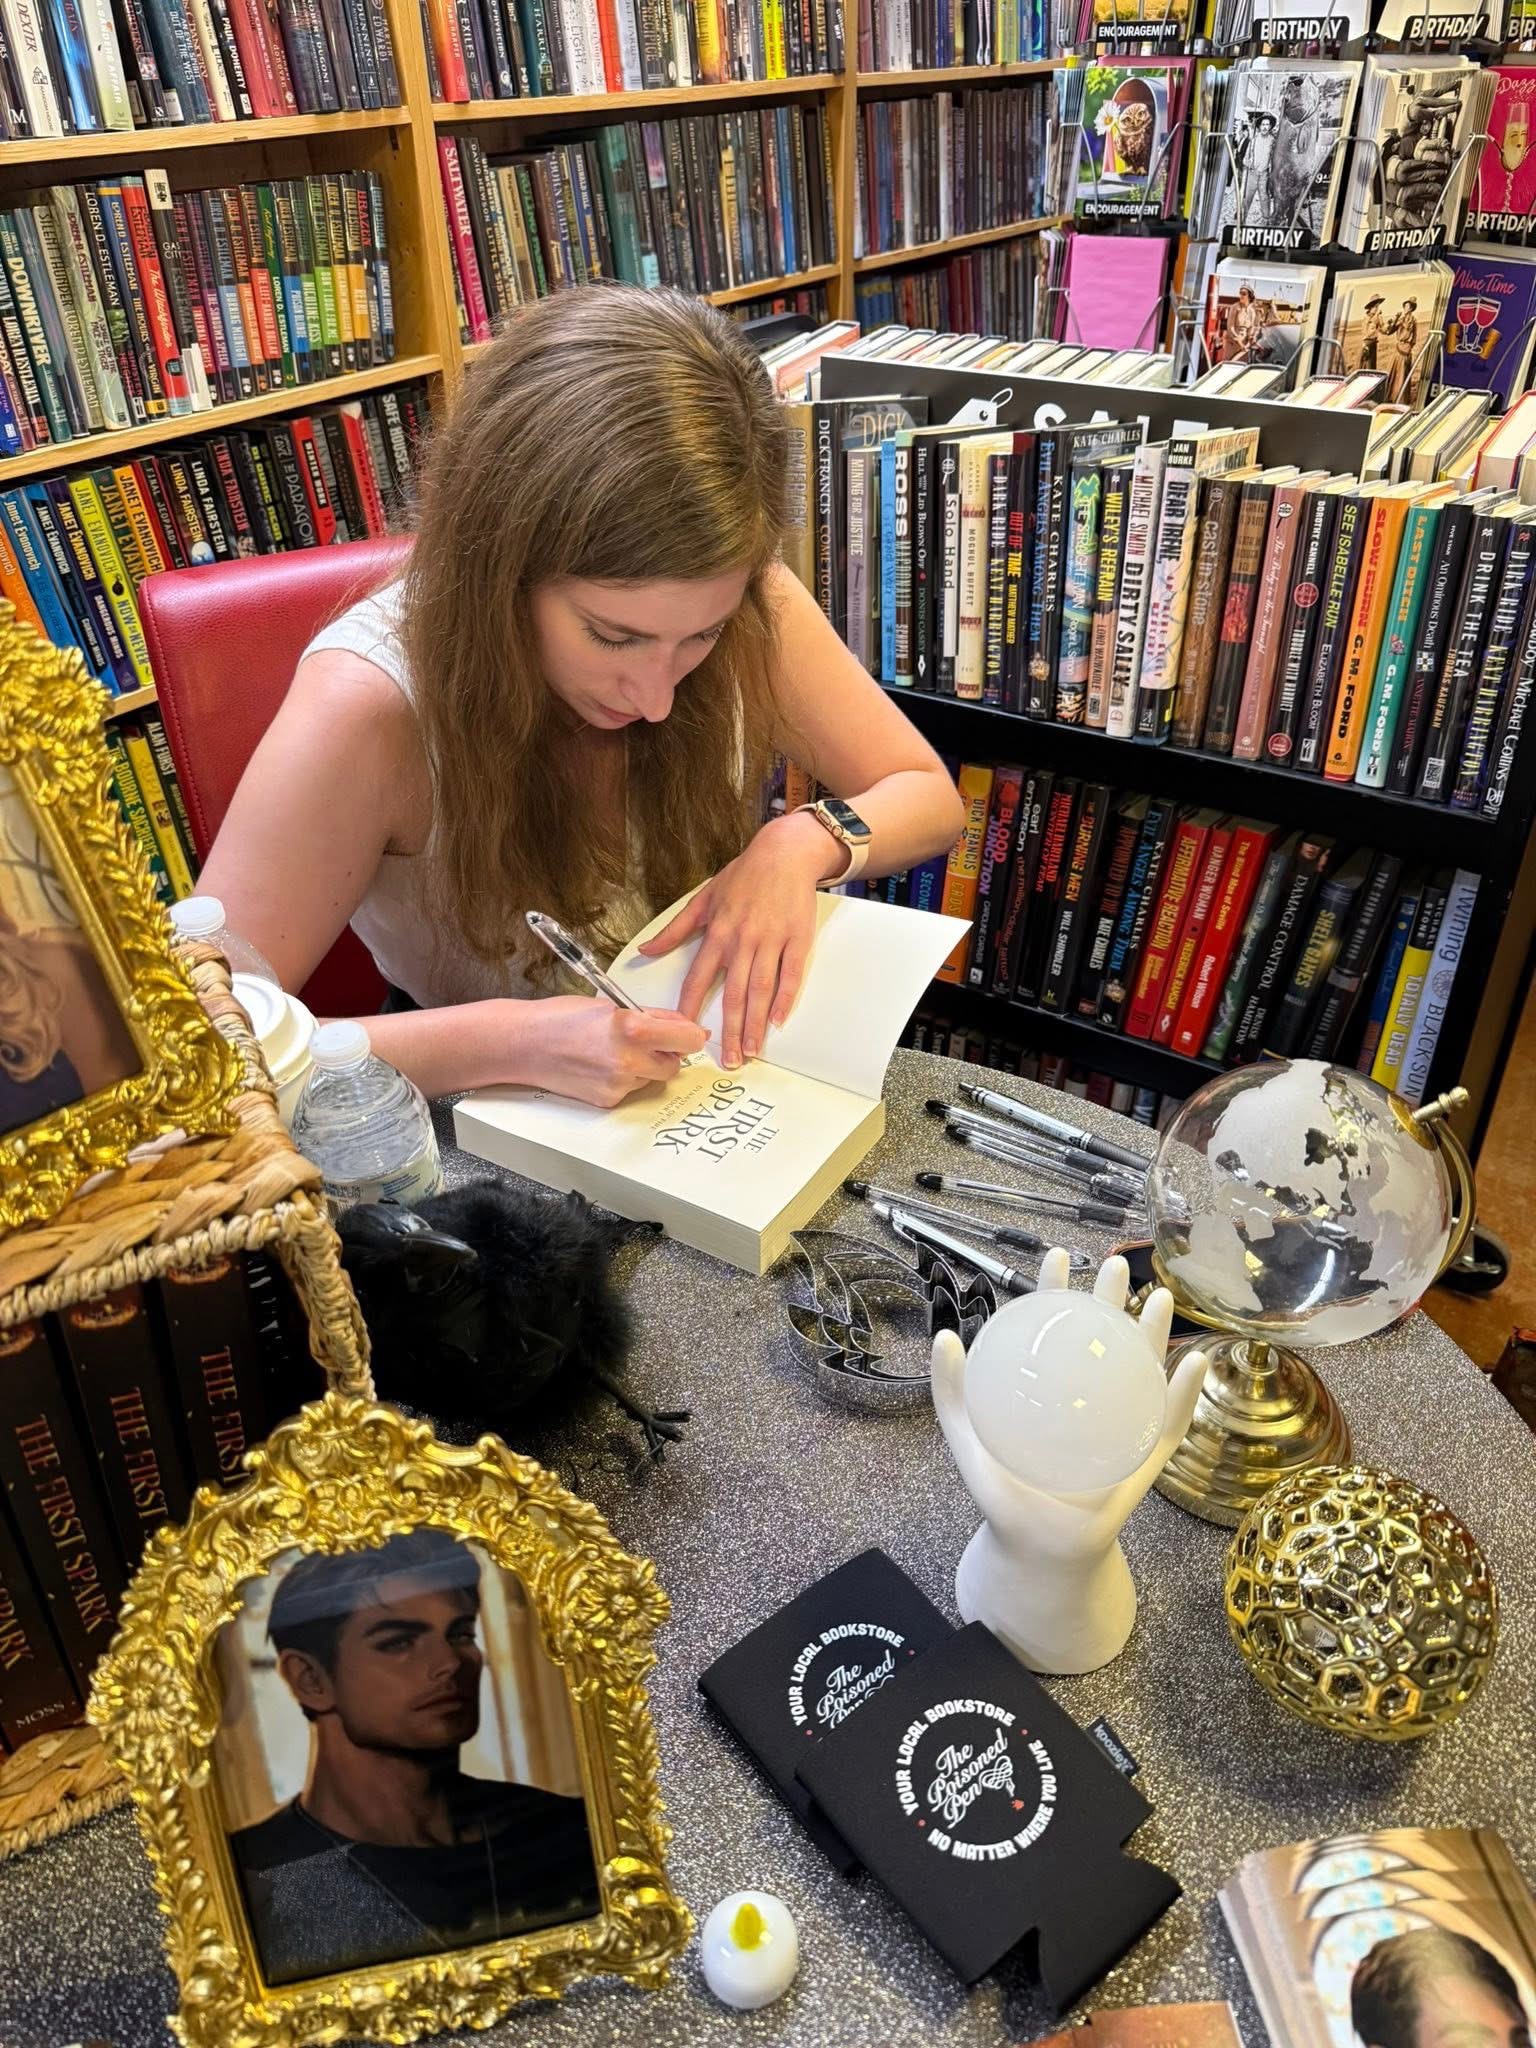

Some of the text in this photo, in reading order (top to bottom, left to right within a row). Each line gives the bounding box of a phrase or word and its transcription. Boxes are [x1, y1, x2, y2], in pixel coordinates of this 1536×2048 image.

[16, 2, 37, 52] DEXTER
[222, 17, 246, 89] PAUL DOHERTY
[357, 4, 373, 67] DUNNING
[461, 17, 474, 58] EXILES
[1099, 24, 1177, 37] ENCOURAGEMENT
[1261, 19, 1342, 40] BIRTHDAY
[1410, 17, 1484, 39] BIRTHDAY
[444, 146, 472, 238] SALTWATER
[1085, 203, 1160, 216] ENCOURAGEMENT
[1465, 211, 1536, 233] BIRTHDAY
[39, 213, 74, 306] SILENT THUNDER
[85, 192, 104, 230] LOREN
[99, 249, 121, 306] ESTLEMAN
[1232, 227, 1305, 248] BIRTHDAY
[1371, 228, 1440, 250] BIRTHDAY
[9, 256, 52, 367] DOWNRIVER
[1453, 265, 1517, 295] Wine Time
[382, 394, 412, 473] SAFE HOUSES
[817, 419, 832, 515] DICK FRANCIS
[1039, 440, 1056, 474] EVIL
[1168, 443, 1193, 465] JAN BURKE
[170, 463, 204, 543] LINDA FAIRSTEIN
[191, 461, 227, 553] LINDA FAIRSTEIN
[305, 441, 327, 505] WINTER WORK
[850, 458, 865, 556] MINING FOR JUSTICE
[1035, 480, 1052, 534] ANGELS
[75, 487, 119, 573] JANET EVANOVICH
[896, 450, 912, 607] ROSS MACDONALD
[943, 499, 957, 590] Solo Hand
[1009, 511, 1024, 532] OUT
[1045, 475, 1063, 612] KATE CHARLES
[1097, 492, 1123, 601] WILEY'S REFRAIN
[1156, 481, 1190, 565] DEAR IRENE,
[1305, 501, 1326, 576] DOROTHY CANNELL
[57, 502, 124, 659] JANET EVANOVICH DANGEROUS MINDS
[965, 528, 976, 607] MOGHUL BUFFET
[1007, 552, 1022, 577] TIME
[1007, 584, 1017, 617] MATTHEW
[1031, 540, 1049, 595] AMONG
[1113, 475, 1154, 688] MICHAEL SIMON DIRTY SALLY
[1191, 520, 1220, 625] cast in stone
[1324, 504, 1357, 628] SEE ISABELLE RUN
[1357, 507, 1387, 628] SLOW BURN
[1029, 603, 1045, 641] THEM
[1288, 629, 1306, 660] TROUBLE
[1453, 551, 1497, 678] DRINK THE TEA
[1285, 662, 1300, 681] WITH
[1308, 643, 1333, 730] ELIZABETH BLOOM
[1431, 647, 1458, 729] THOMAS KAUFMAN
[1338, 683, 1356, 740] FORD
[146, 721, 176, 776] ALAN FURST
[115, 761, 141, 809] BOURNE
[128, 807, 160, 858] SACRIFICE
[963, 799, 986, 871] DICK FRANCIS
[979, 807, 1013, 895] BLOOD JUNCTION
[1064, 815, 1094, 902] BURNING MEN
[1164, 836, 1196, 903] AFFIRMATIVE
[1204, 846, 1225, 883] DANGER
[1150, 902, 1178, 950] REACTION
[1192, 885, 1213, 920] WOMAN
[1258, 874, 1308, 991] DAMAGE CONTROL
[1051, 909, 1073, 976] WILL SHINDLER
[1174, 937, 1196, 980] FREDERICK
[1294, 909, 1336, 988] SHELL GAMES
[1165, 980, 1185, 1010] RAMSAY
[1235, 995, 1260, 1045] HAMILTON
[1248, 1007, 1267, 1040] DENISE
[1384, 975, 1422, 1066] TOTALLY DEAD
[1403, 887, 1478, 1099] Twining BLACK SUN
[652, 1078, 746, 1156] SPARK
[696, 1097, 776, 1163] FIRST
[743, 1126, 780, 1154] THE
[110, 1386, 168, 1519] THE FIRST
[15, 1413, 112, 1634] THE FIRST SPARK
[788, 1623, 905, 1726] YOUR LOCAL BOOKSTORE
[816, 1649, 895, 1724] Poisoned
[826, 1664, 862, 1694] The
[16, 1702, 65, 1729] MOSS
[895, 1699, 1016, 1816] YOUR LOCAL BOOKSTORE
[927, 1727, 1008, 1813] Poisoned
[935, 1743, 974, 1779] The
[927, 1739, 1058, 1861] NO MATTER WHERE YOU LIVE
[943, 1782, 983, 1829] Pen
